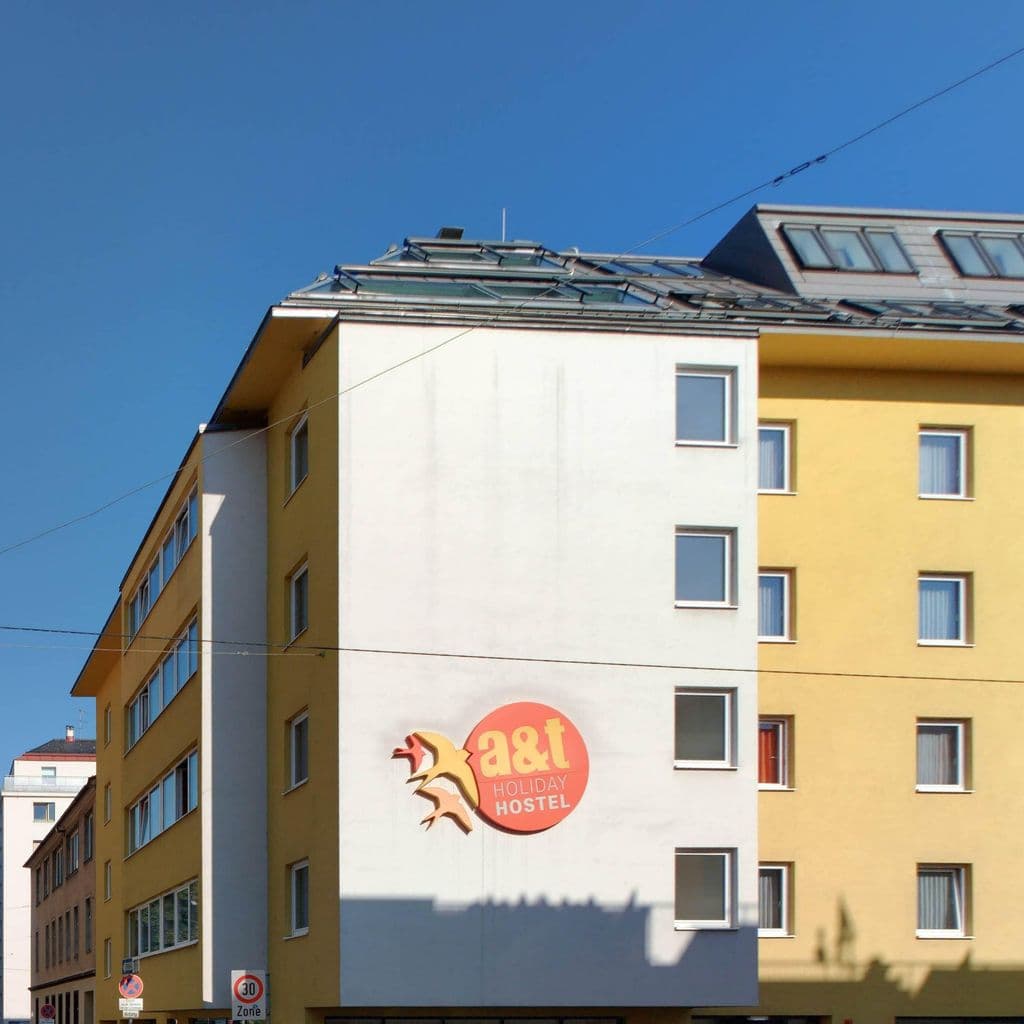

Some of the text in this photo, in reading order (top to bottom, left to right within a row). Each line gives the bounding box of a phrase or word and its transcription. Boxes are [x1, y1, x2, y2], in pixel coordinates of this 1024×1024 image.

[479, 717, 570, 778] a&t
[493, 774, 569, 798] HOLIDAY
[495, 794, 571, 816] HOSTEL
[242, 982, 256, 996] 30
[237, 1005, 262, 1017] Zone
